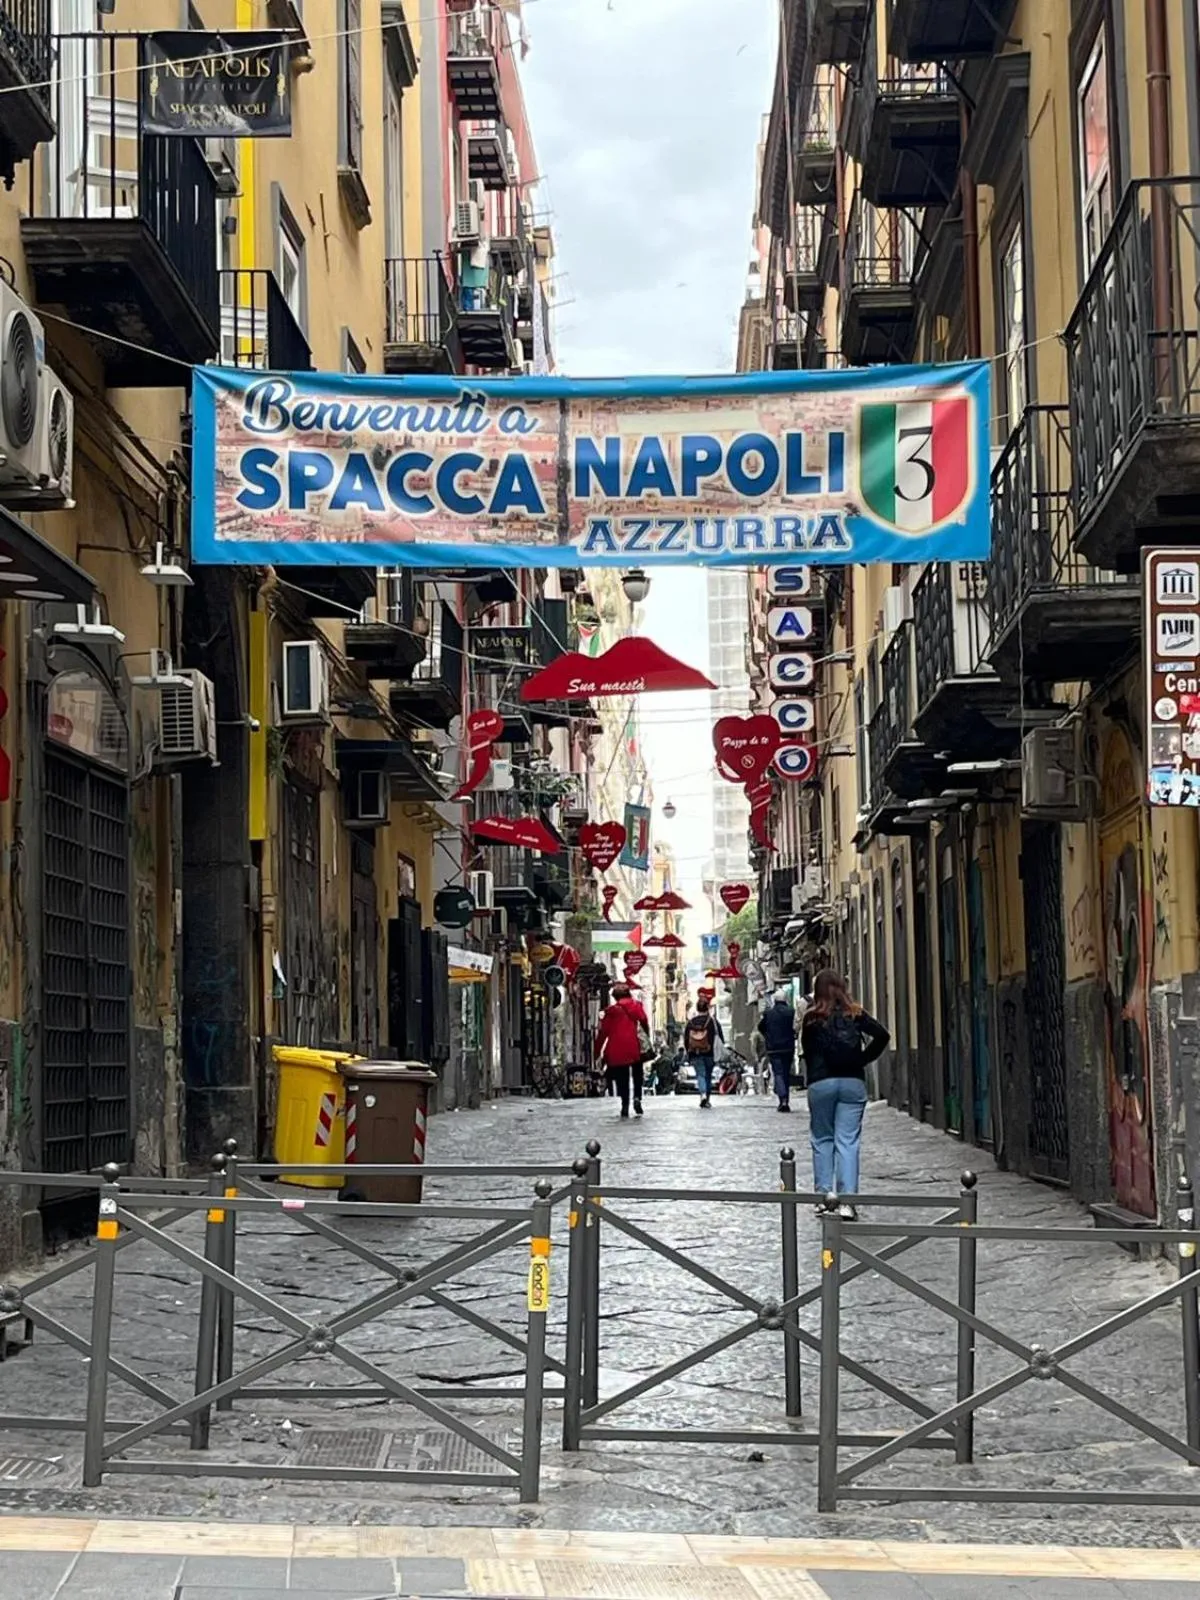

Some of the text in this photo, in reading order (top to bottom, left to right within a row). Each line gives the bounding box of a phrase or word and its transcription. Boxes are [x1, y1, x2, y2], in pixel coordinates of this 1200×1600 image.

[165, 56, 271, 78] NEAPOLIS
[242, 379, 538, 434] Benvenuti a
[235, 431, 845, 515] SPACCA NAPOLI
[893, 426, 936, 501] 3
[582, 513, 851, 552] AZZURRA
[566, 678, 597, 693] Sua
[1164, 673, 1200, 692] Cen
